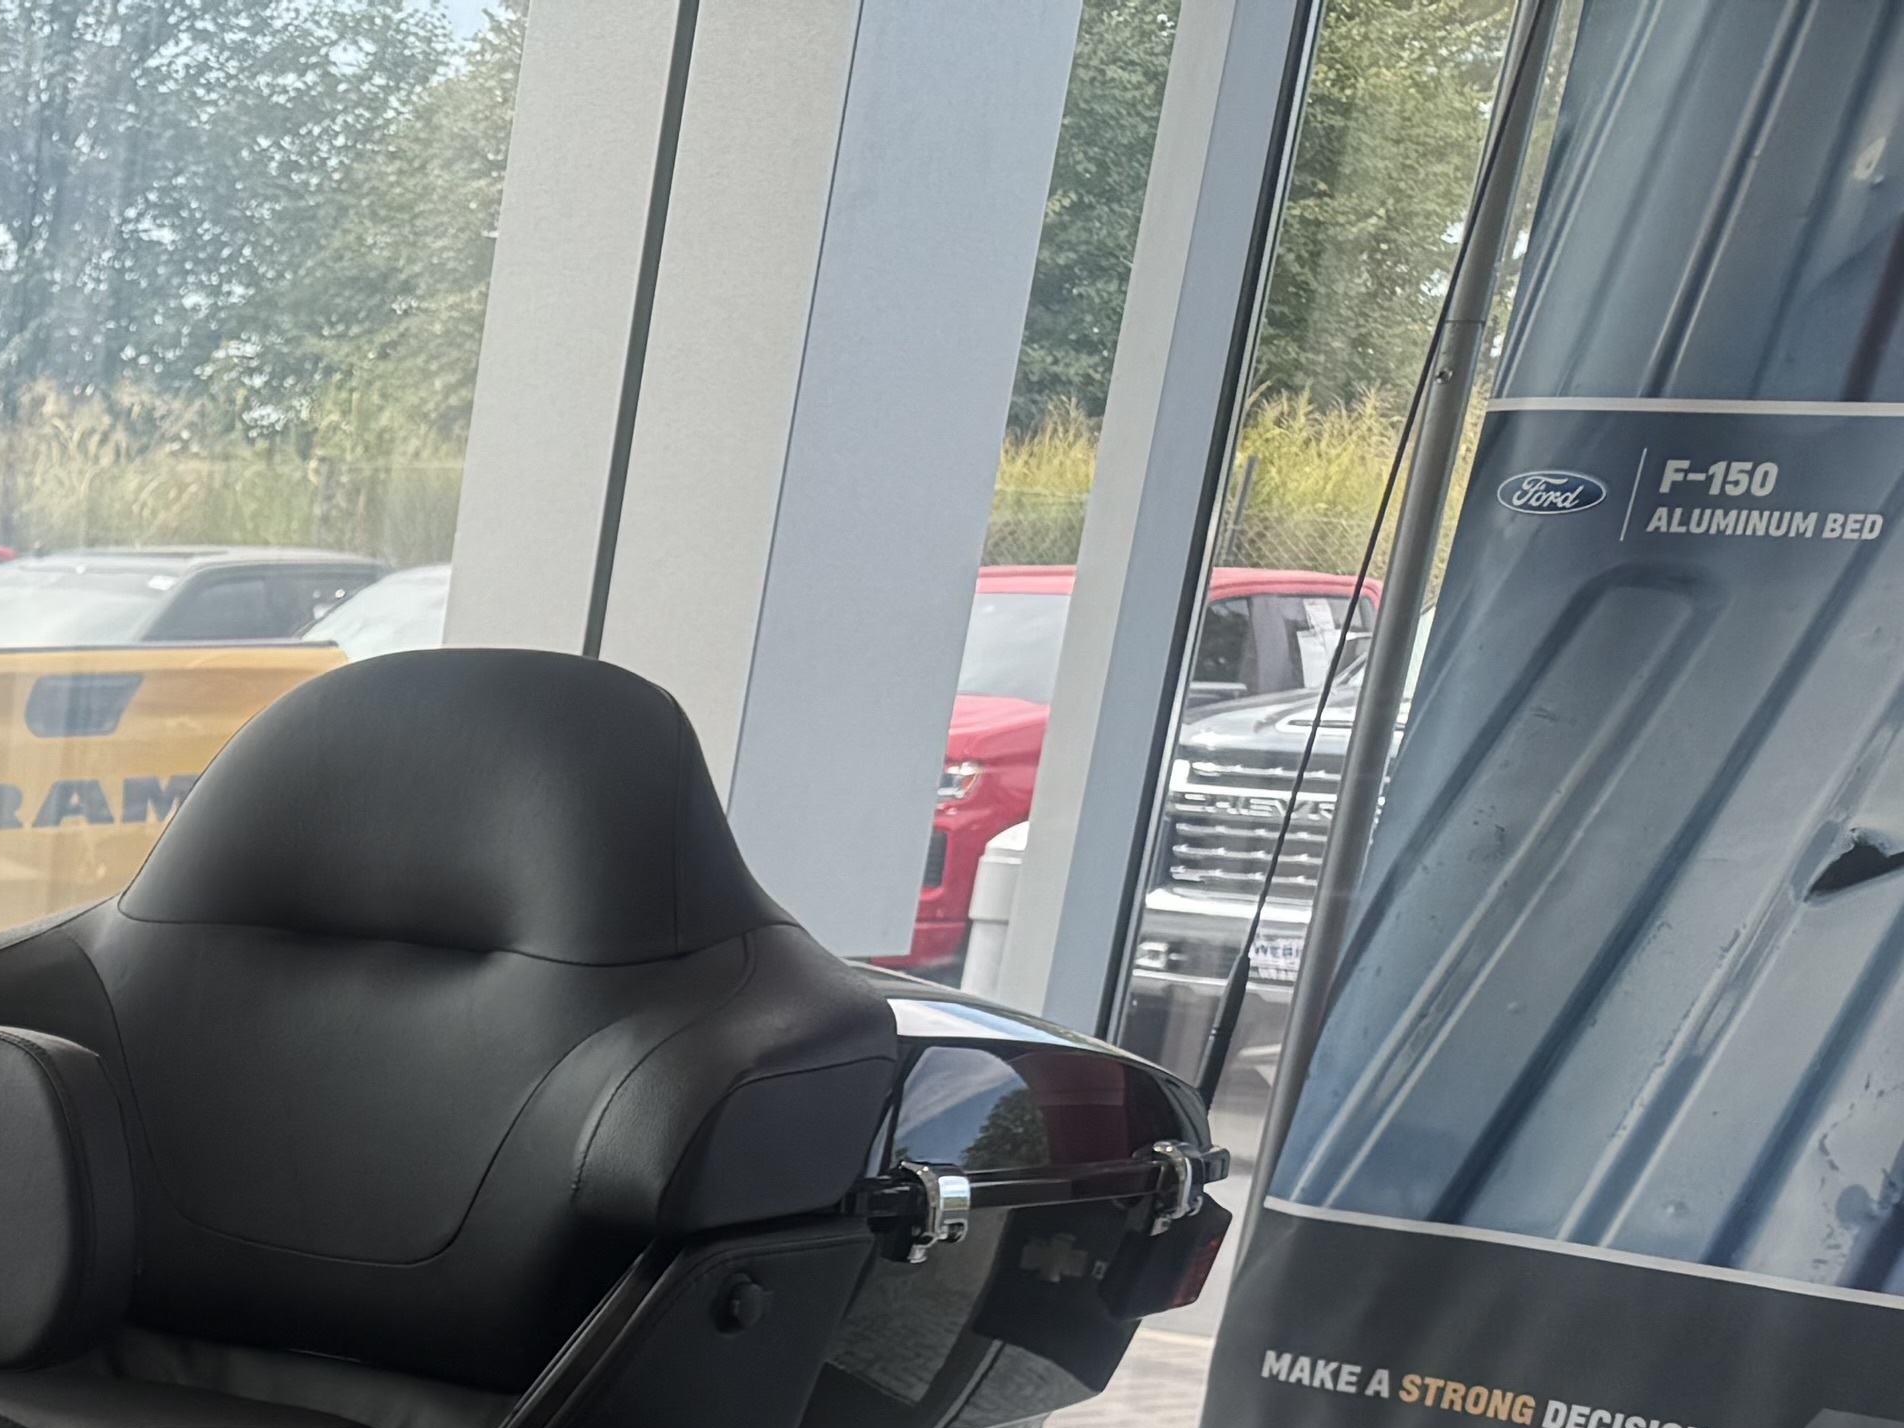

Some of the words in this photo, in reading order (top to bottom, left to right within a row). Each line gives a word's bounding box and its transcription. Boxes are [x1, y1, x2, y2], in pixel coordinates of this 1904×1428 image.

[1658, 459, 1780, 497] F-150
[1645, 506, 1817, 538] ALUMINUM
[1821, 512, 1884, 541] BED
[1260, 1349, 1361, 1395] MAKE
[1365, 1369, 1390, 1399] A
[1398, 1373, 1536, 1426] STRONG
